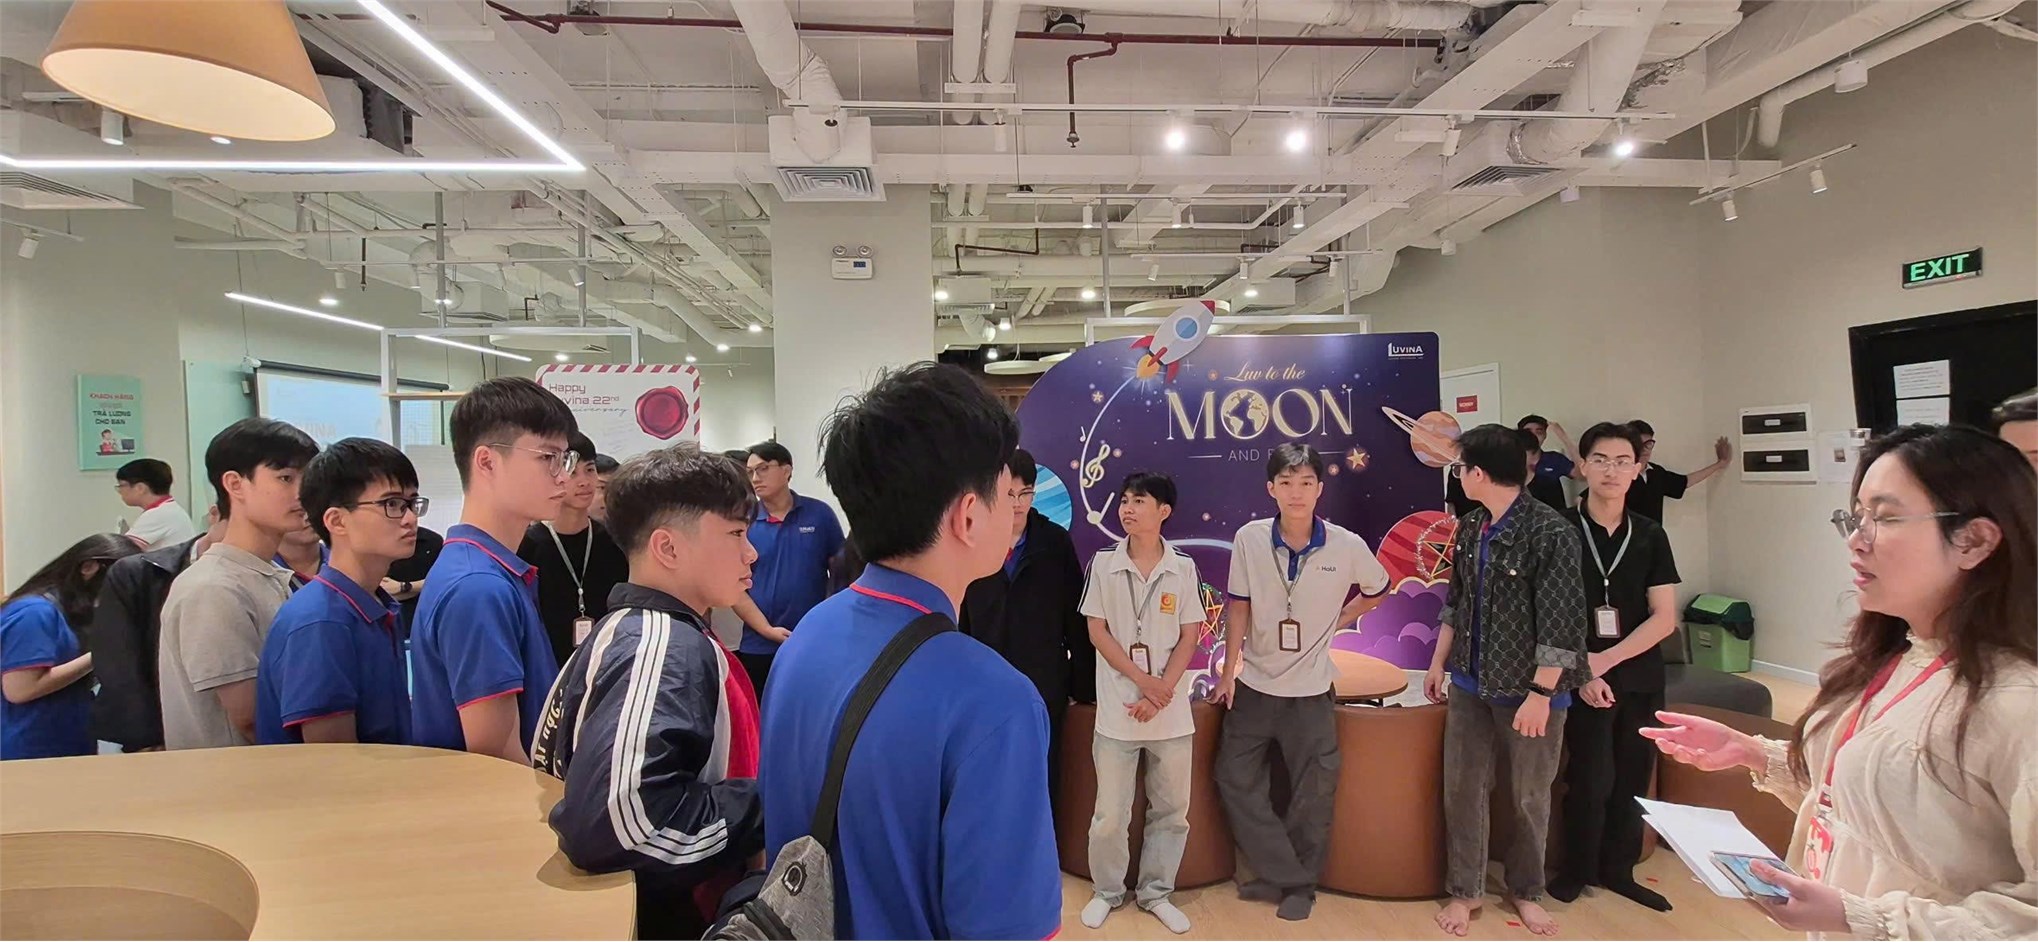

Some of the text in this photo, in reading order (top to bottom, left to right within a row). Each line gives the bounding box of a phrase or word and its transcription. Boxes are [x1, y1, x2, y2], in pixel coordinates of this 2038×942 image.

[1910, 254, 1969, 281] EXIT
[1224, 362, 1306, 382] Luv to the
[549, 383, 586, 394] Happy
[561, 394, 620, 405] vina 22nd
[1165, 388, 1353, 440] MOON
[1228, 449, 1260, 462] AND
